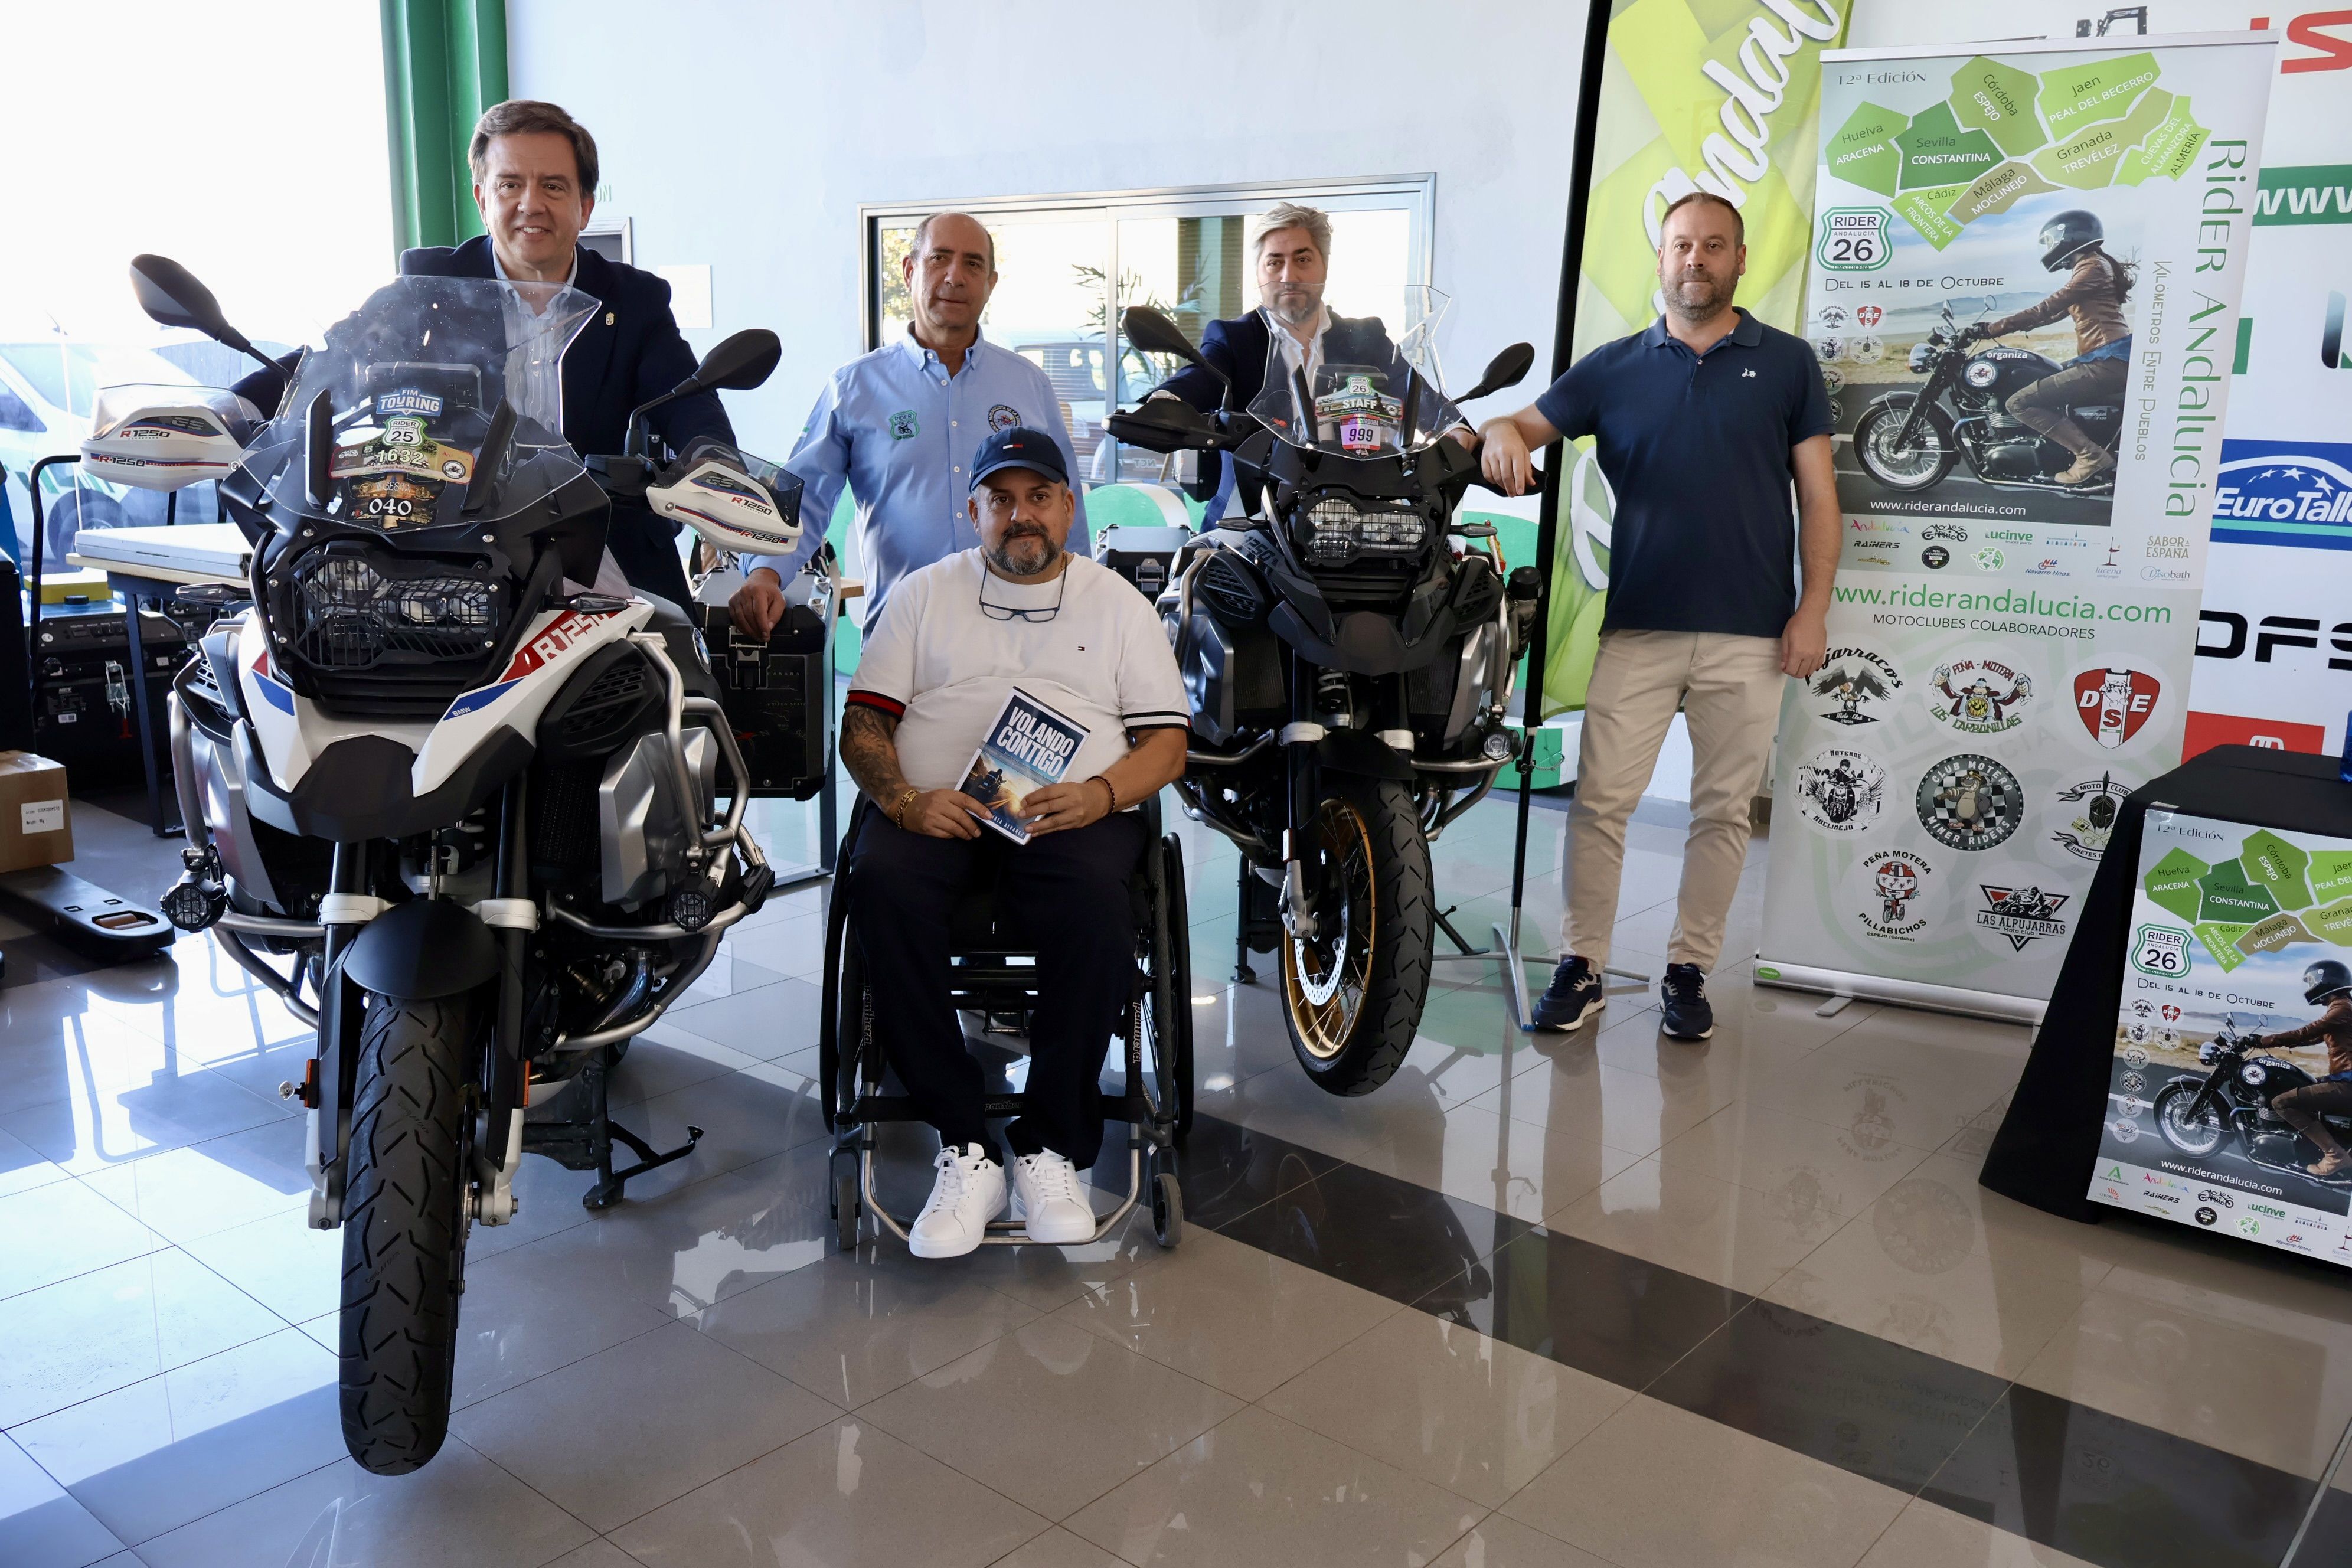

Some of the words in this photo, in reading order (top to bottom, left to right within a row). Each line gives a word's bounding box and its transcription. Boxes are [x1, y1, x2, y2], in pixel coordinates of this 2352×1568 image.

[1984, 74, 2018, 116] Córdoba
[2071, 76, 2101, 97] Jaen
[1973, 91, 2000, 121] ESPEJO
[2049, 106, 2077, 123] PEAL
[2077, 95, 2101, 111] DEL
[2101, 71, 2154, 100] BECERRO
[1842, 125, 1883, 144] Huelva
[1916, 137, 1955, 148] Sevilla
[2141, 131, 2167, 165] CUEVAS
[2165, 116, 2181, 132] DEL
[1836, 143, 1884, 165] ARACENA
[2057, 130, 2113, 160] Granada
[2151, 122, 2193, 175] ALMANZORA
[2170, 132, 2200, 175] ALMERÍA
[1912, 153, 1991, 165] CONSTANTINA
[2062, 143, 2121, 175] TREVÉLEZ
[1973, 168, 2015, 198] Málaga
[1927, 189, 1956, 200] Cádiz
[1971, 175, 2027, 215] MOCLINEJO
[1834, 217, 1876, 227] RIDER
[1905, 207, 1939, 241] FRONTERA
[1912, 195, 1935, 220] ARCOS
[1933, 215, 1946, 228] DE
[1941, 224, 1954, 237] LA
[1833, 239, 1873, 262] 26
[1861, 280, 1870, 289] 15
[1878, 280, 1892, 288] AL
[1899, 279, 1909, 288] 18
[1917, 279, 1933, 288] DE
[1987, 351, 2027, 360] organiza
[380, 396, 440, 412] TOURING
[1342, 398, 1377, 409] STAFF
[391, 430, 413, 442] 25
[1349, 429, 1373, 442] 999
[377, 449, 424, 465] 1632
[369, 498, 412, 516] 040
[744, 499, 772, 515] 1250
[1870, 499, 2026, 515] www.riderandalucia.com
[2147, 535, 2184, 547] SABOR
[2146, 547, 2189, 558] ESPAÑA
[1831, 584, 2171, 624] ww.riderandalucia.com
[1873, 613, 1966, 629] MOTOCLUBES
[1970, 620, 2095, 639] COLABORADORES
[452, 706, 472, 717] BMW
[1008, 707, 1074, 757] VOLANDO
[997, 726, 1063, 776] CONTIGO
[1830, 750, 1861, 759] MOTEROS
[1932, 762, 1960, 783] CLUB
[1968, 760, 2013, 791] MOTERO
[2111, 785, 2129, 795] CLUB
[1813, 815, 1854, 831] MOCLINEJO
[1927, 815, 1961, 843] MINER
[1968, 821, 2010, 845] RIDERS
[2070, 846, 2097, 858] JINETES
[2267, 844, 2291, 879] Córdoba
[1863, 851, 1890, 867] PEÑA
[1893, 851, 1932, 874] MOTERA
[2158, 867, 2190, 876] Huelva
[2259, 856, 2278, 880] ESPEJO
[2152, 881, 2190, 891] ARACENA
[2214, 883, 2243, 894] Sevilla
[2315, 880, 2336, 891] PEAL
[2210, 896, 2269, 910] CONSTANTINA
[1858, 912, 1927, 935] PILLABICHOS
[1977, 914, 1995, 925] LAS
[1999, 917, 2066, 935] ALPUJARRAS
[2255, 919, 2288, 937] Málaga
[1889, 934, 1915, 942] (Córdoba)
[2148, 932, 2181, 944] RIDER
[2209, 926, 2225, 946] ARCOS
[2224, 946, 2233, 955] DE
[2230, 953, 2239, 963] LA
[2253, 926, 2297, 950] MOCLINEJO
[2145, 949, 2177, 970] 26
[2203, 934, 2227, 965] FRONTERA
[2259, 1059, 2291, 1070] organiza
[2161, 1159, 2282, 1195] www.riderandalucia.com
